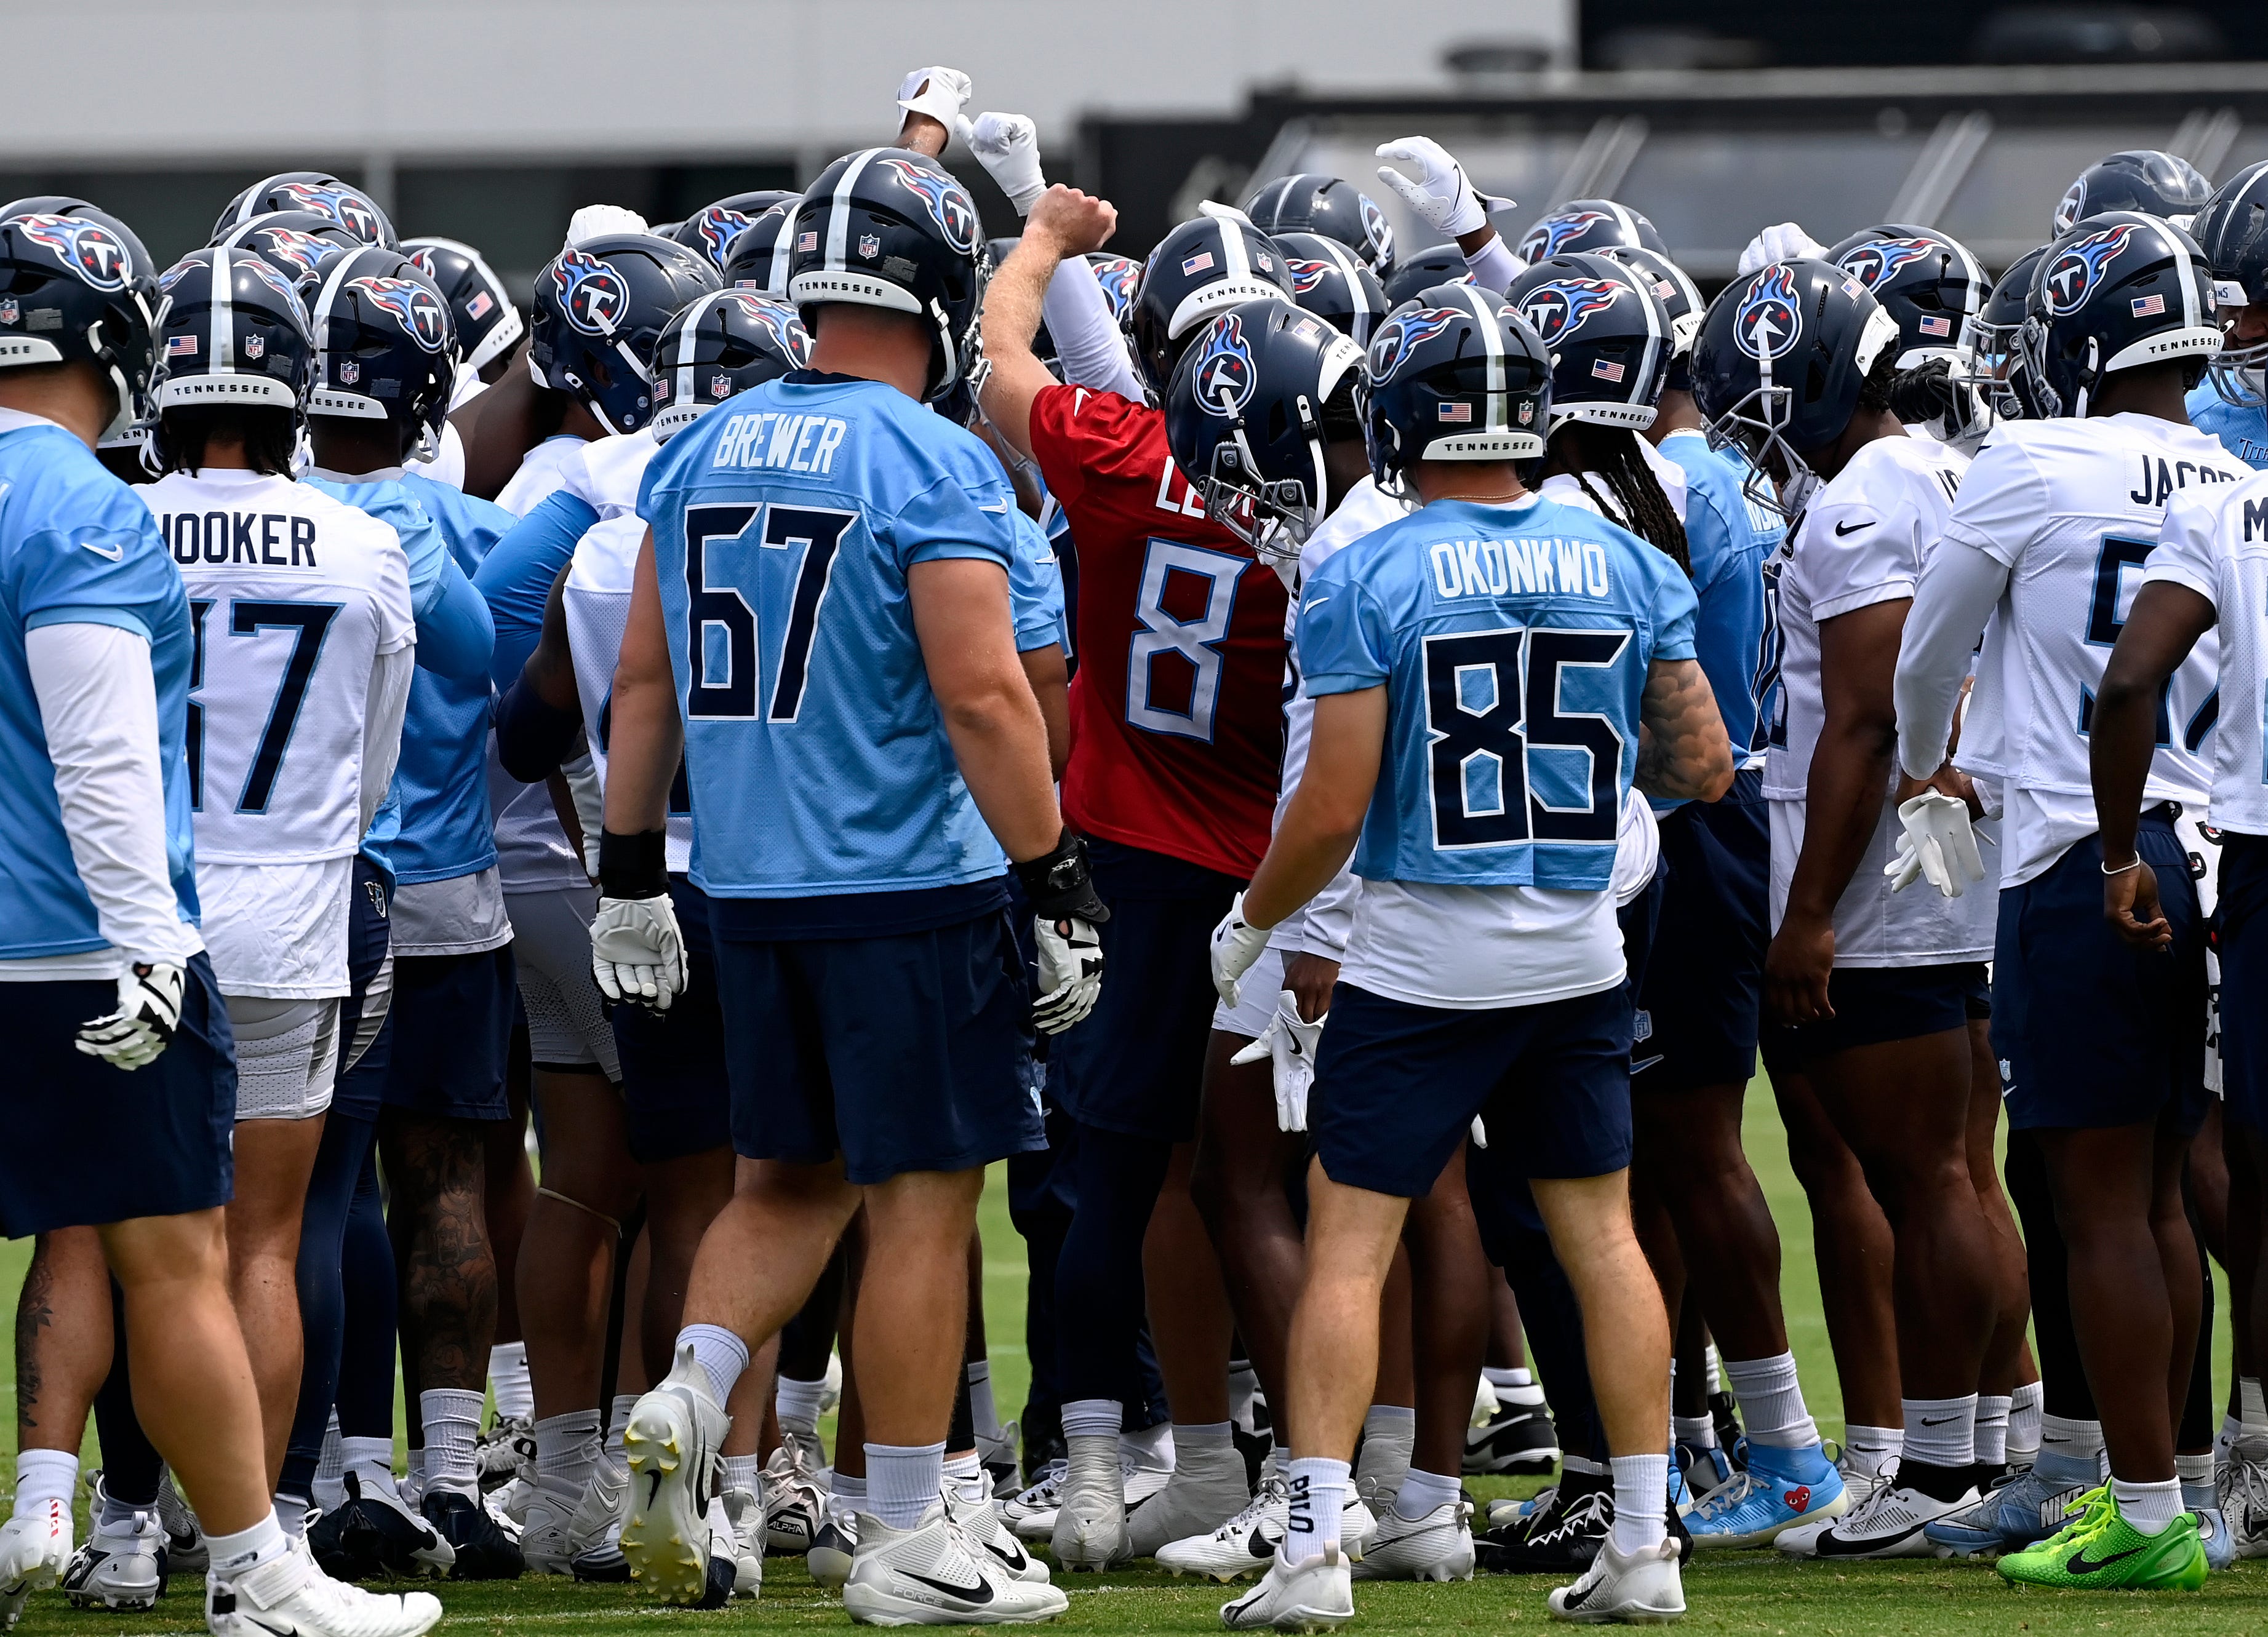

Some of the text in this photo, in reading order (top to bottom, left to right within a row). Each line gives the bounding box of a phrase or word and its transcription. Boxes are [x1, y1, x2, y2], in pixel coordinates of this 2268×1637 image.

[799, 282, 884, 296] TENNESSEE
[1196, 286, 1280, 303] TENNESSE
[2149, 338, 2219, 354] TENNESSEE
[174, 384, 271, 396] TENNESSEE
[309, 397, 365, 410] ESSEE
[656, 413, 698, 429] TENNES
[1589, 409, 1655, 424] TENNESSEE
[712, 412, 847, 474] BREWER
[1444, 442, 1535, 452] TENNESSEE
[1429, 538, 1610, 598] OKONKWO
[684, 501, 861, 724] 67
[1125, 536, 1255, 746] 8
[1421, 626, 1634, 851] 85
[769, 1521, 803, 1535] ALPHA
[893, 1585, 944, 1607] FORCE
